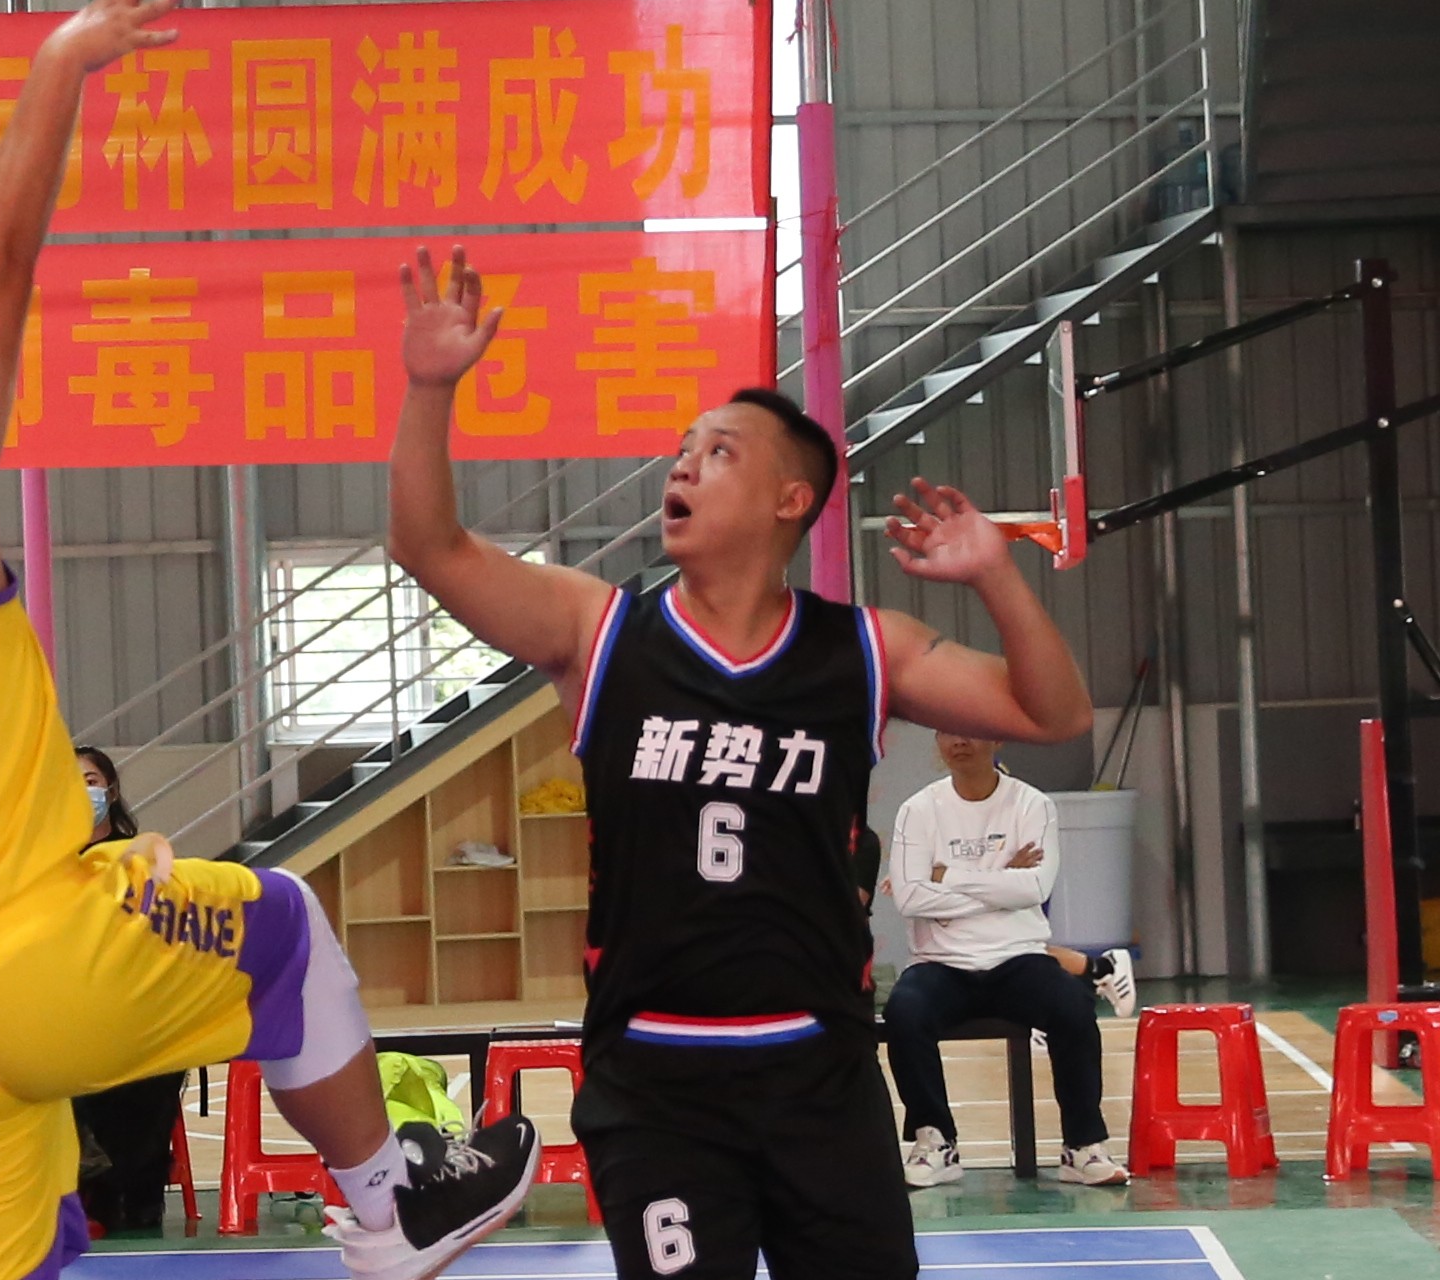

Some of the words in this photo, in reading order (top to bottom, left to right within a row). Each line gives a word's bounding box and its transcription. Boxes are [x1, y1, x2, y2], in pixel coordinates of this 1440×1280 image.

[629, 716, 826, 796] 新势力
[697, 802, 744, 882] 6
[643, 1198, 696, 1275] 6
